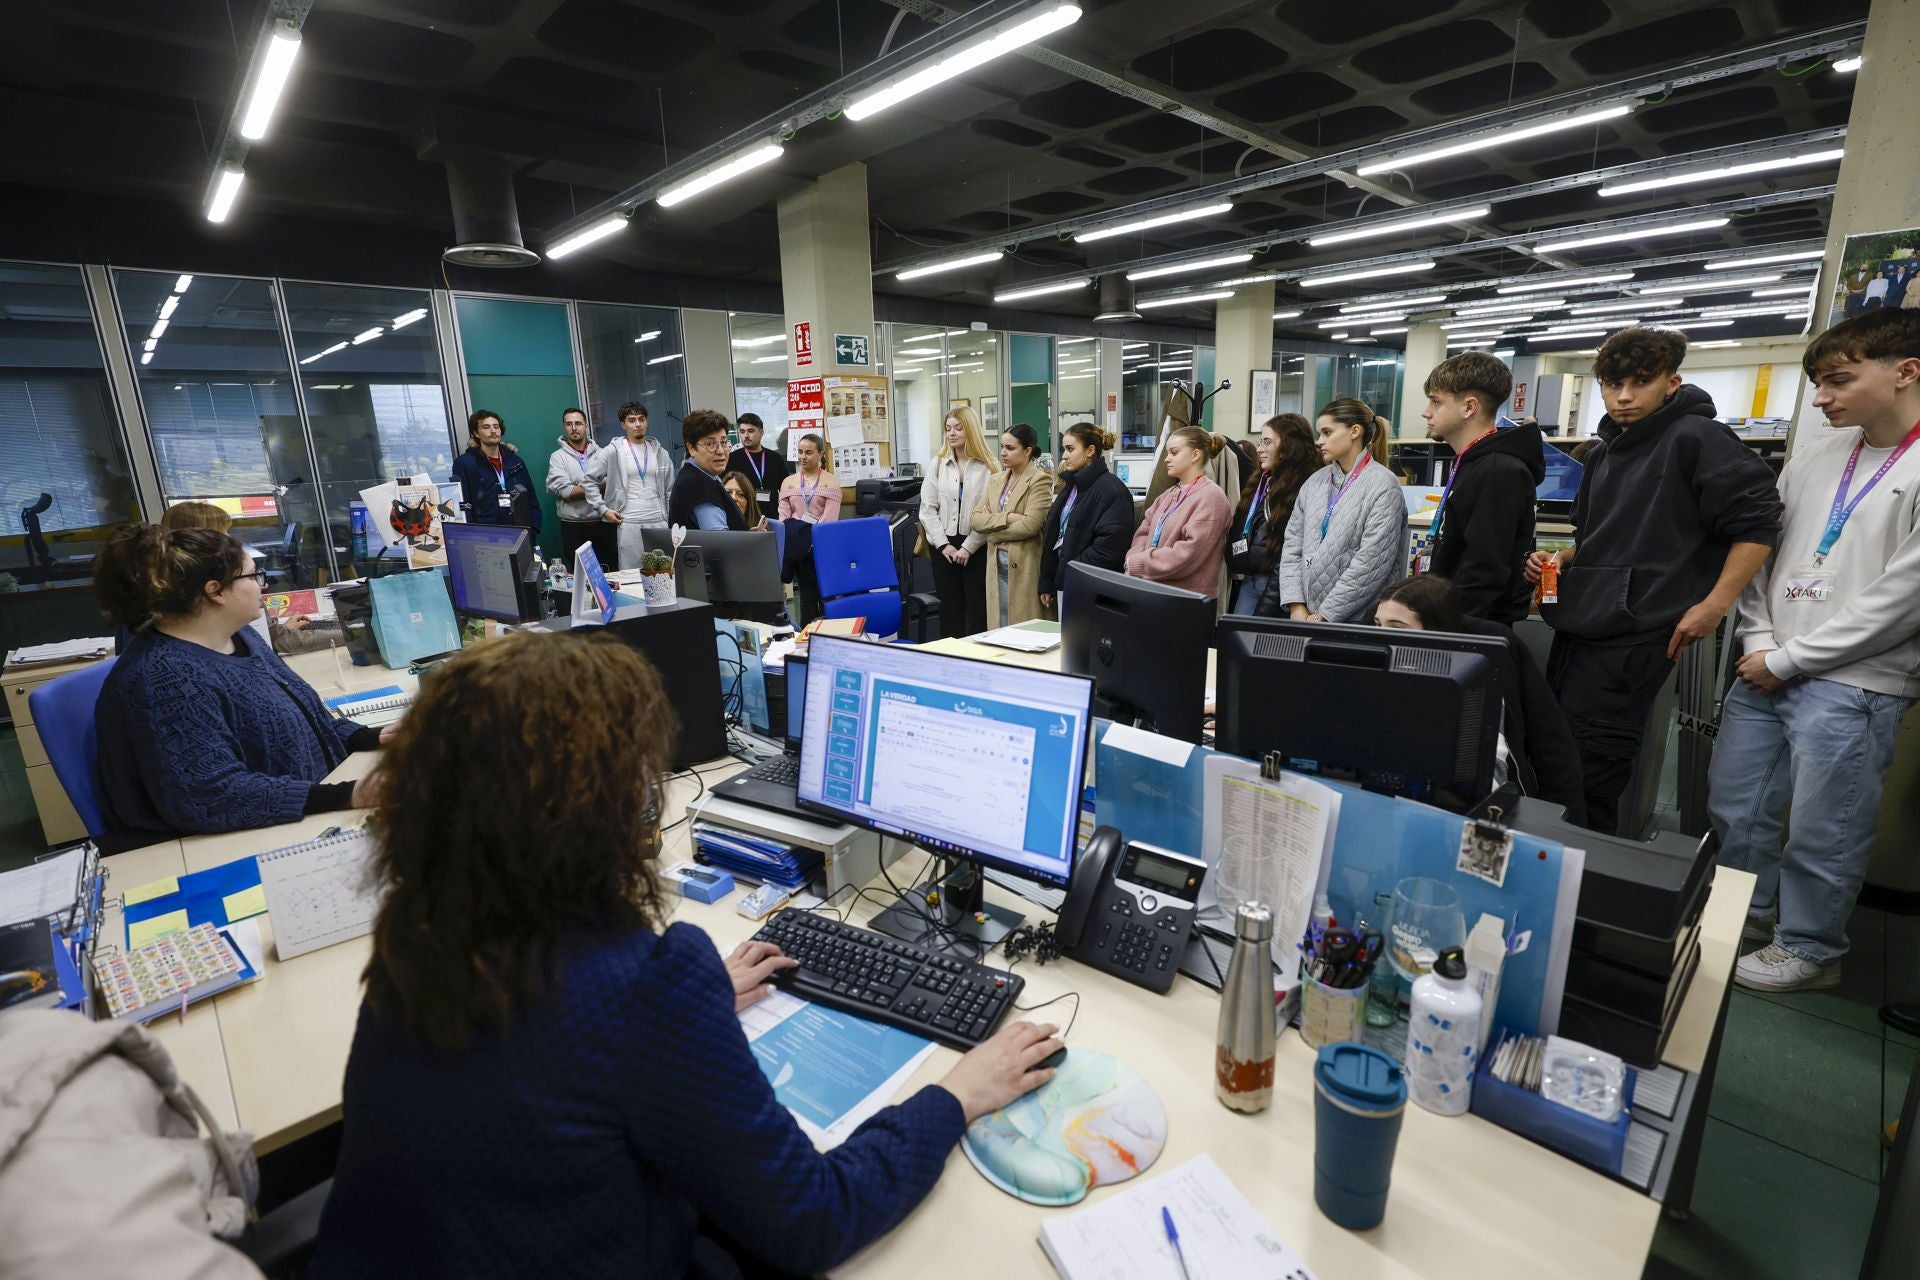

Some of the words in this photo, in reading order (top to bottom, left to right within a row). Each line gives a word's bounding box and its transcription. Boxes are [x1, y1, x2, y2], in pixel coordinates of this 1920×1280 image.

[790, 383, 799, 392] 20
[801, 383, 821, 393] CCOO
[790, 393, 800, 401] 26
[1678, 713, 1694, 729] LA
